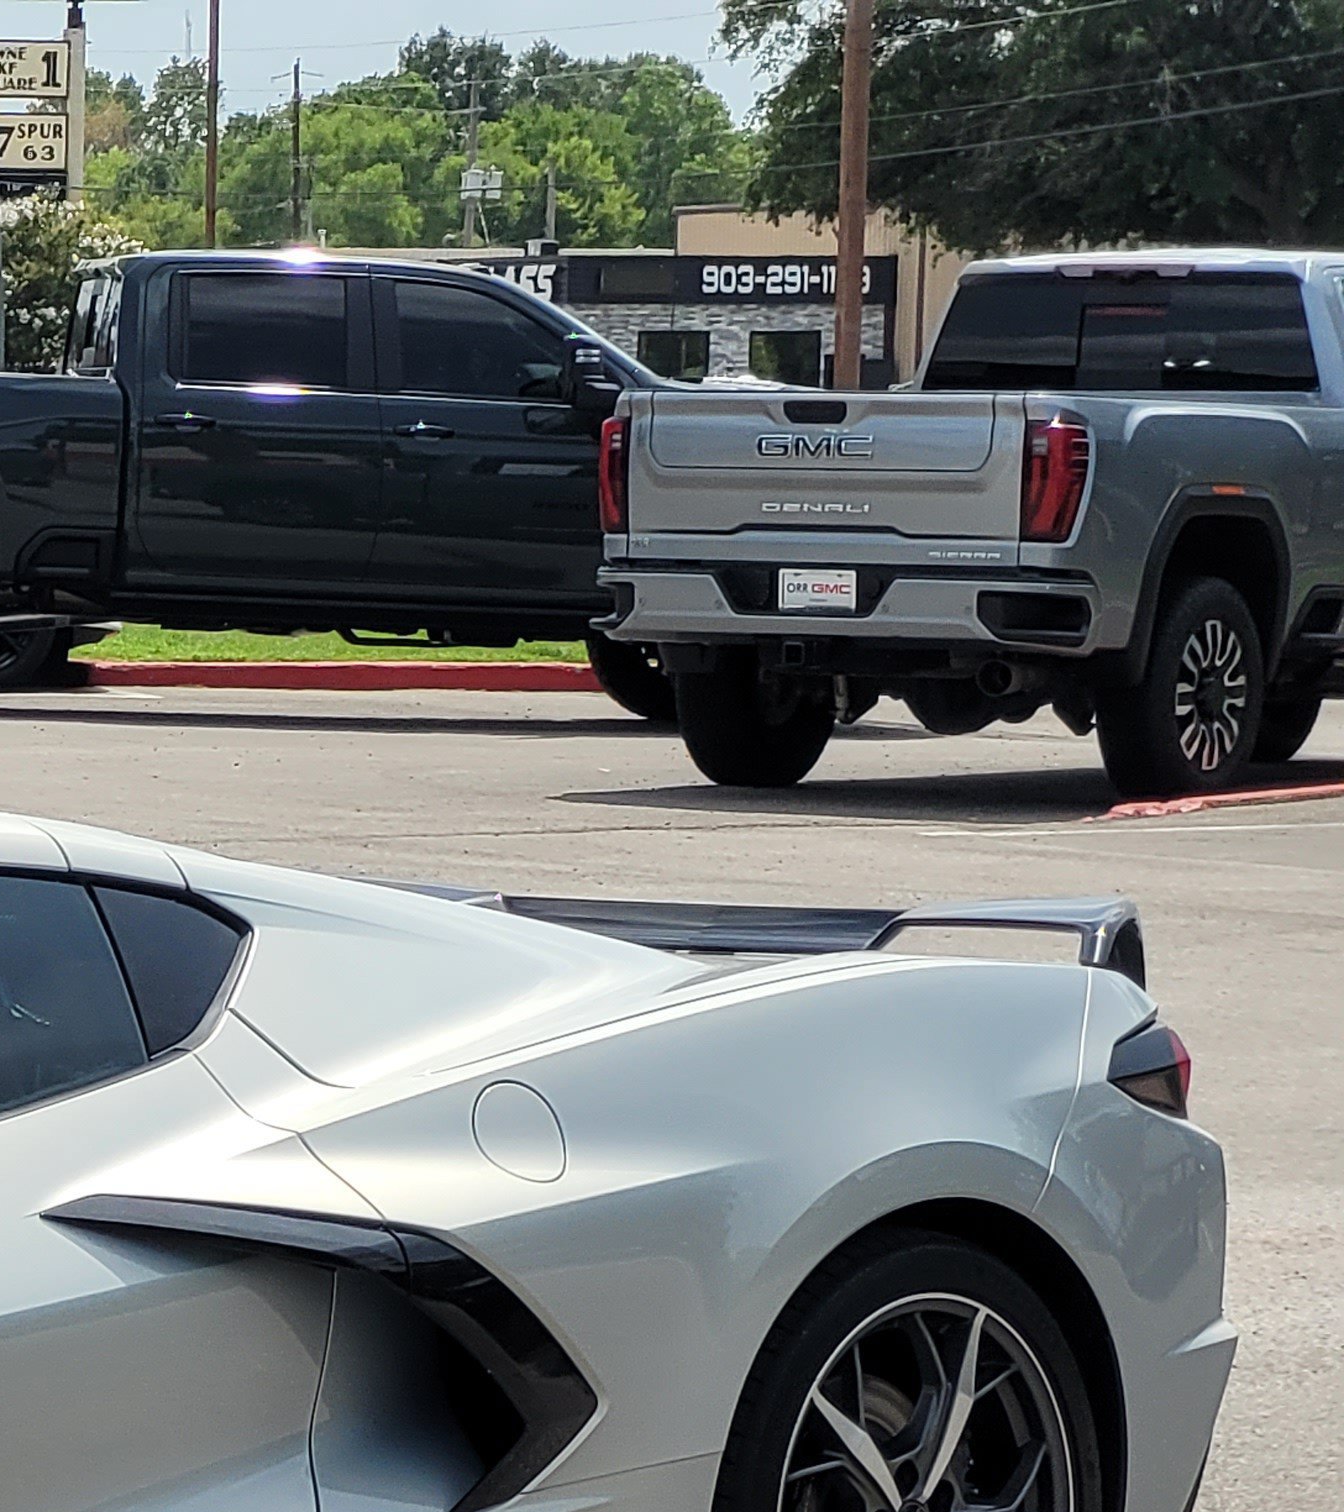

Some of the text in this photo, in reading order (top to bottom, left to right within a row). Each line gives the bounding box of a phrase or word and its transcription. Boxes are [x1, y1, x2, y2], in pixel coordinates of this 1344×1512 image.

[17, 123, 63, 139] SPUR
[23, 145, 55, 161] 63
[757, 434, 874, 460] GMC
[761, 503, 870, 513] DENALI
[928, 551, 1001, 560] SIERRA
[786, 583, 852, 595] ORR GMC
